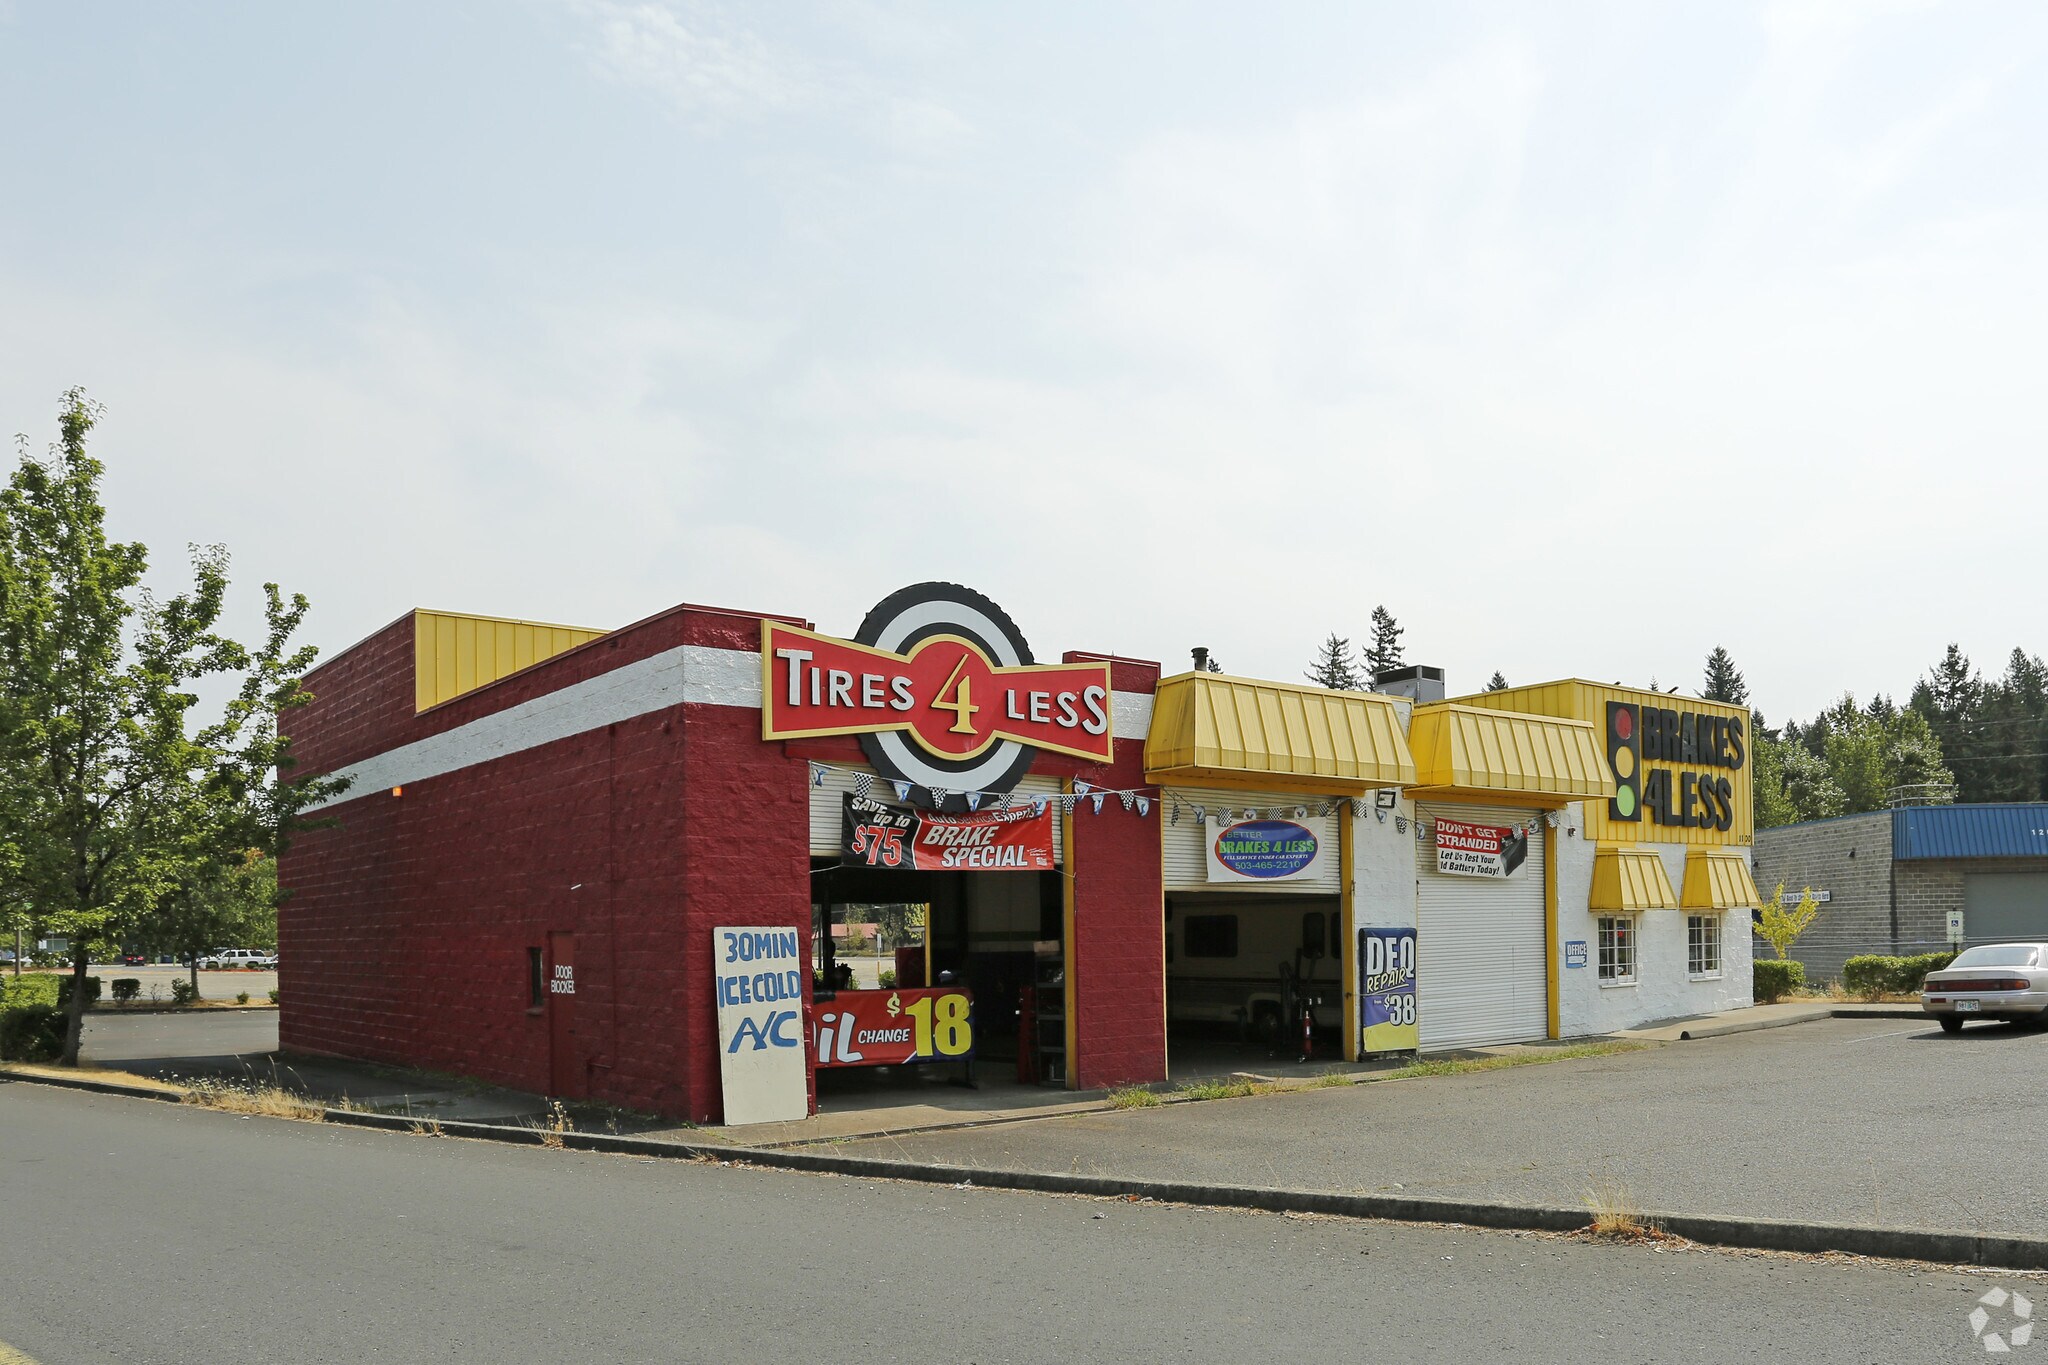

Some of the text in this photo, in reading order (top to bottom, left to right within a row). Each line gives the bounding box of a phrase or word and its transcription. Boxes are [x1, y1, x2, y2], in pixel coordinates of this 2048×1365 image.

[776, 648, 1108, 736] TIRES 4 LESS
[1642, 705, 1745, 770] BRAKES
[852, 797, 888, 815] SAVE
[873, 813, 911, 828] up to
[923, 825, 999, 846] BRAKE
[1226, 831, 1263, 839] BETTER
[1437, 821, 1497, 838] DON'T GET
[852, 824, 907, 867] $75
[1219, 840, 1315, 854] BRAKES 4 LESS
[1436, 834, 1498, 851] STRANDED
[941, 845, 1029, 868] SPECIAL
[1235, 860, 1301, 870] 503-465-2210
[1440, 851, 1454, 860] Let
[1464, 853, 1479, 863] Test
[1480, 854, 1496, 864] Your
[1449, 862, 1475, 874] Battery
[1476, 865, 1500, 876] Today!
[1366, 936, 1415, 978] DEQ
[1567, 943, 1587, 956] OFFICE
[555, 965, 573, 980] DOOR
[1366, 967, 1406, 994] REPAIR
[1384, 993, 1416, 1026] $38
[727, 1011, 798, 1053] A/C
[858, 1028, 911, 1044] CHANGE
